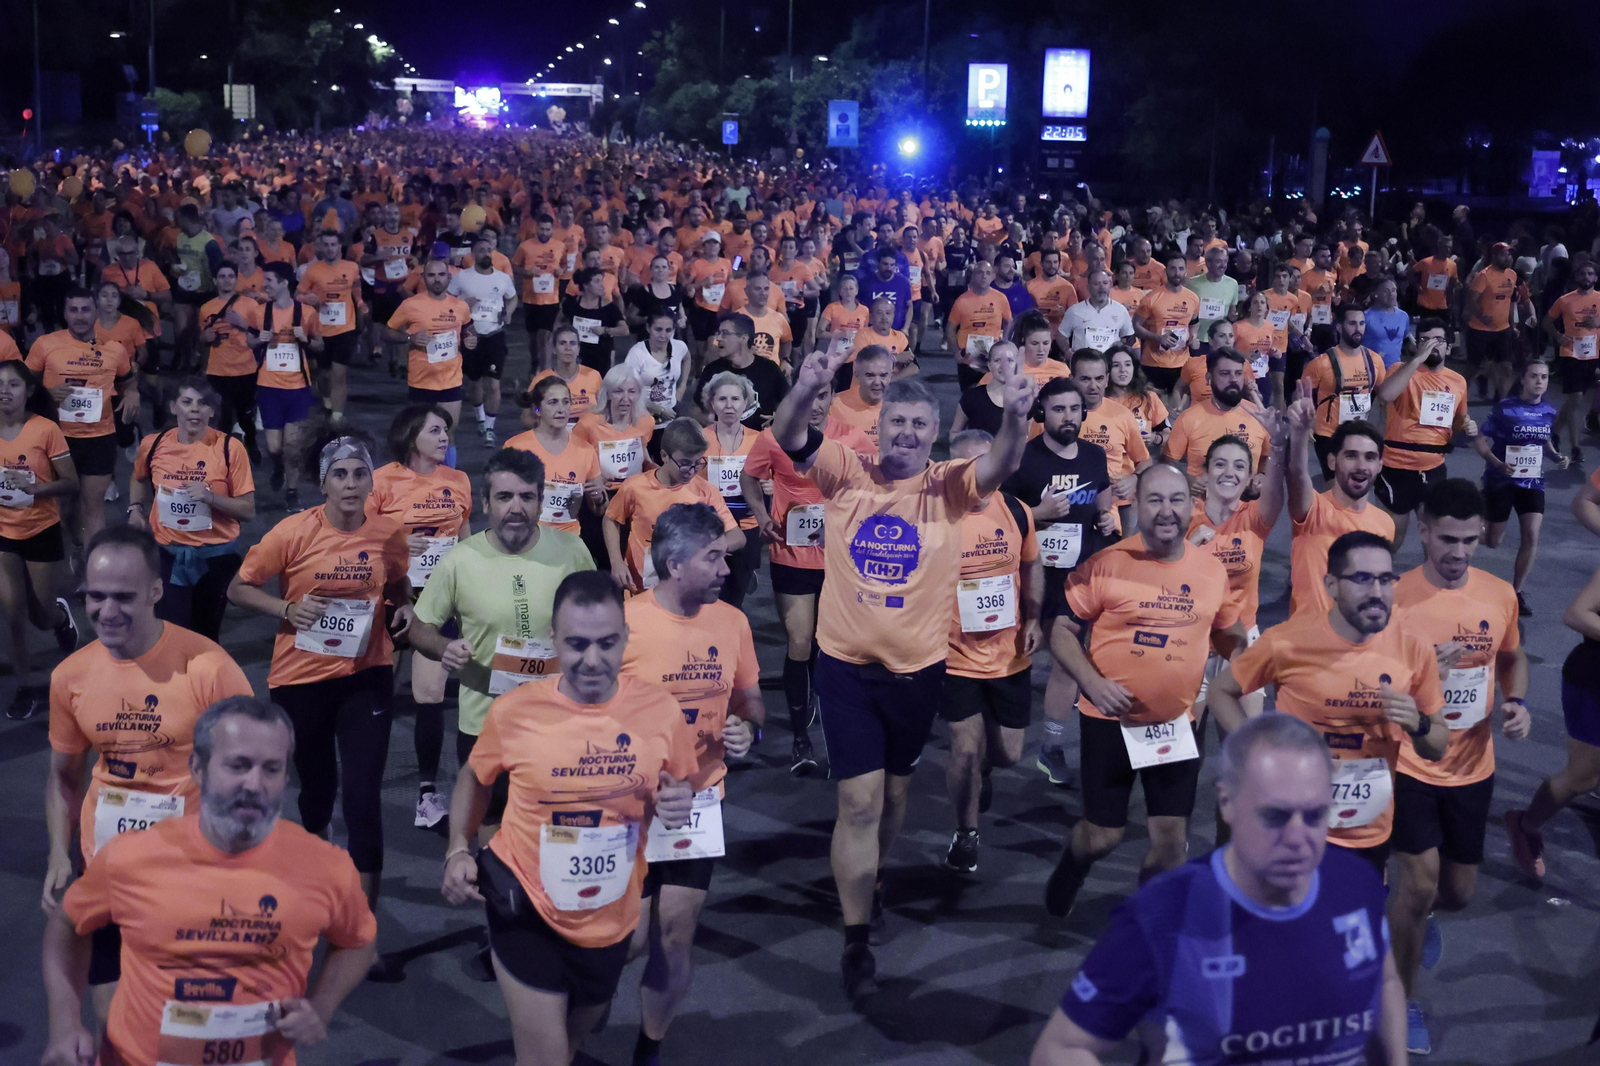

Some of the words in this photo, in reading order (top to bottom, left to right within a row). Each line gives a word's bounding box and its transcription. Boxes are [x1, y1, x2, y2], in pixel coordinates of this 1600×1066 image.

[978, 68, 1001, 100] P
[726, 123, 735, 134] P
[1043, 126, 1083, 138] 22:05
[274, 352, 295, 360] 11773
[71, 398, 92, 409] 5948
[611, 451, 637, 463] 15617
[1515, 456, 1537, 465] 10195
[1048, 474, 1080, 491] JUST
[170, 502, 197, 514] 6967
[854, 538, 867, 548] LA
[867, 540, 918, 552] NOCTURNA
[1041, 537, 1069, 551] 4512
[314, 572, 352, 580] SEVILLA
[976, 593, 1005, 610] 3368
[1138, 601, 1173, 610] SEVILLA
[1156, 595, 1195, 605] NOCTURNA
[319, 615, 355, 632] 6966
[519, 658, 546, 674] 780
[681, 663, 723, 671] NOCTURNA
[661, 672, 701, 683] SEVILLA
[1347, 691, 1380, 699] NOCTU
[1324, 698, 1369, 708] SEVILLA
[115, 712, 162, 722] NOCTURNA
[95, 722, 138, 732] SEVILLA
[1145, 722, 1175, 740] 4847
[578, 754, 638, 765] NOCTURNA
[551, 766, 605, 777] SEVILLA
[1331, 782, 1371, 800] 7743
[569, 854, 617, 876] 3305
[209, 918, 282, 930] NOCTURNA
[175, 929, 240, 942] SEVILLA
[202, 1039, 245, 1065] 580
